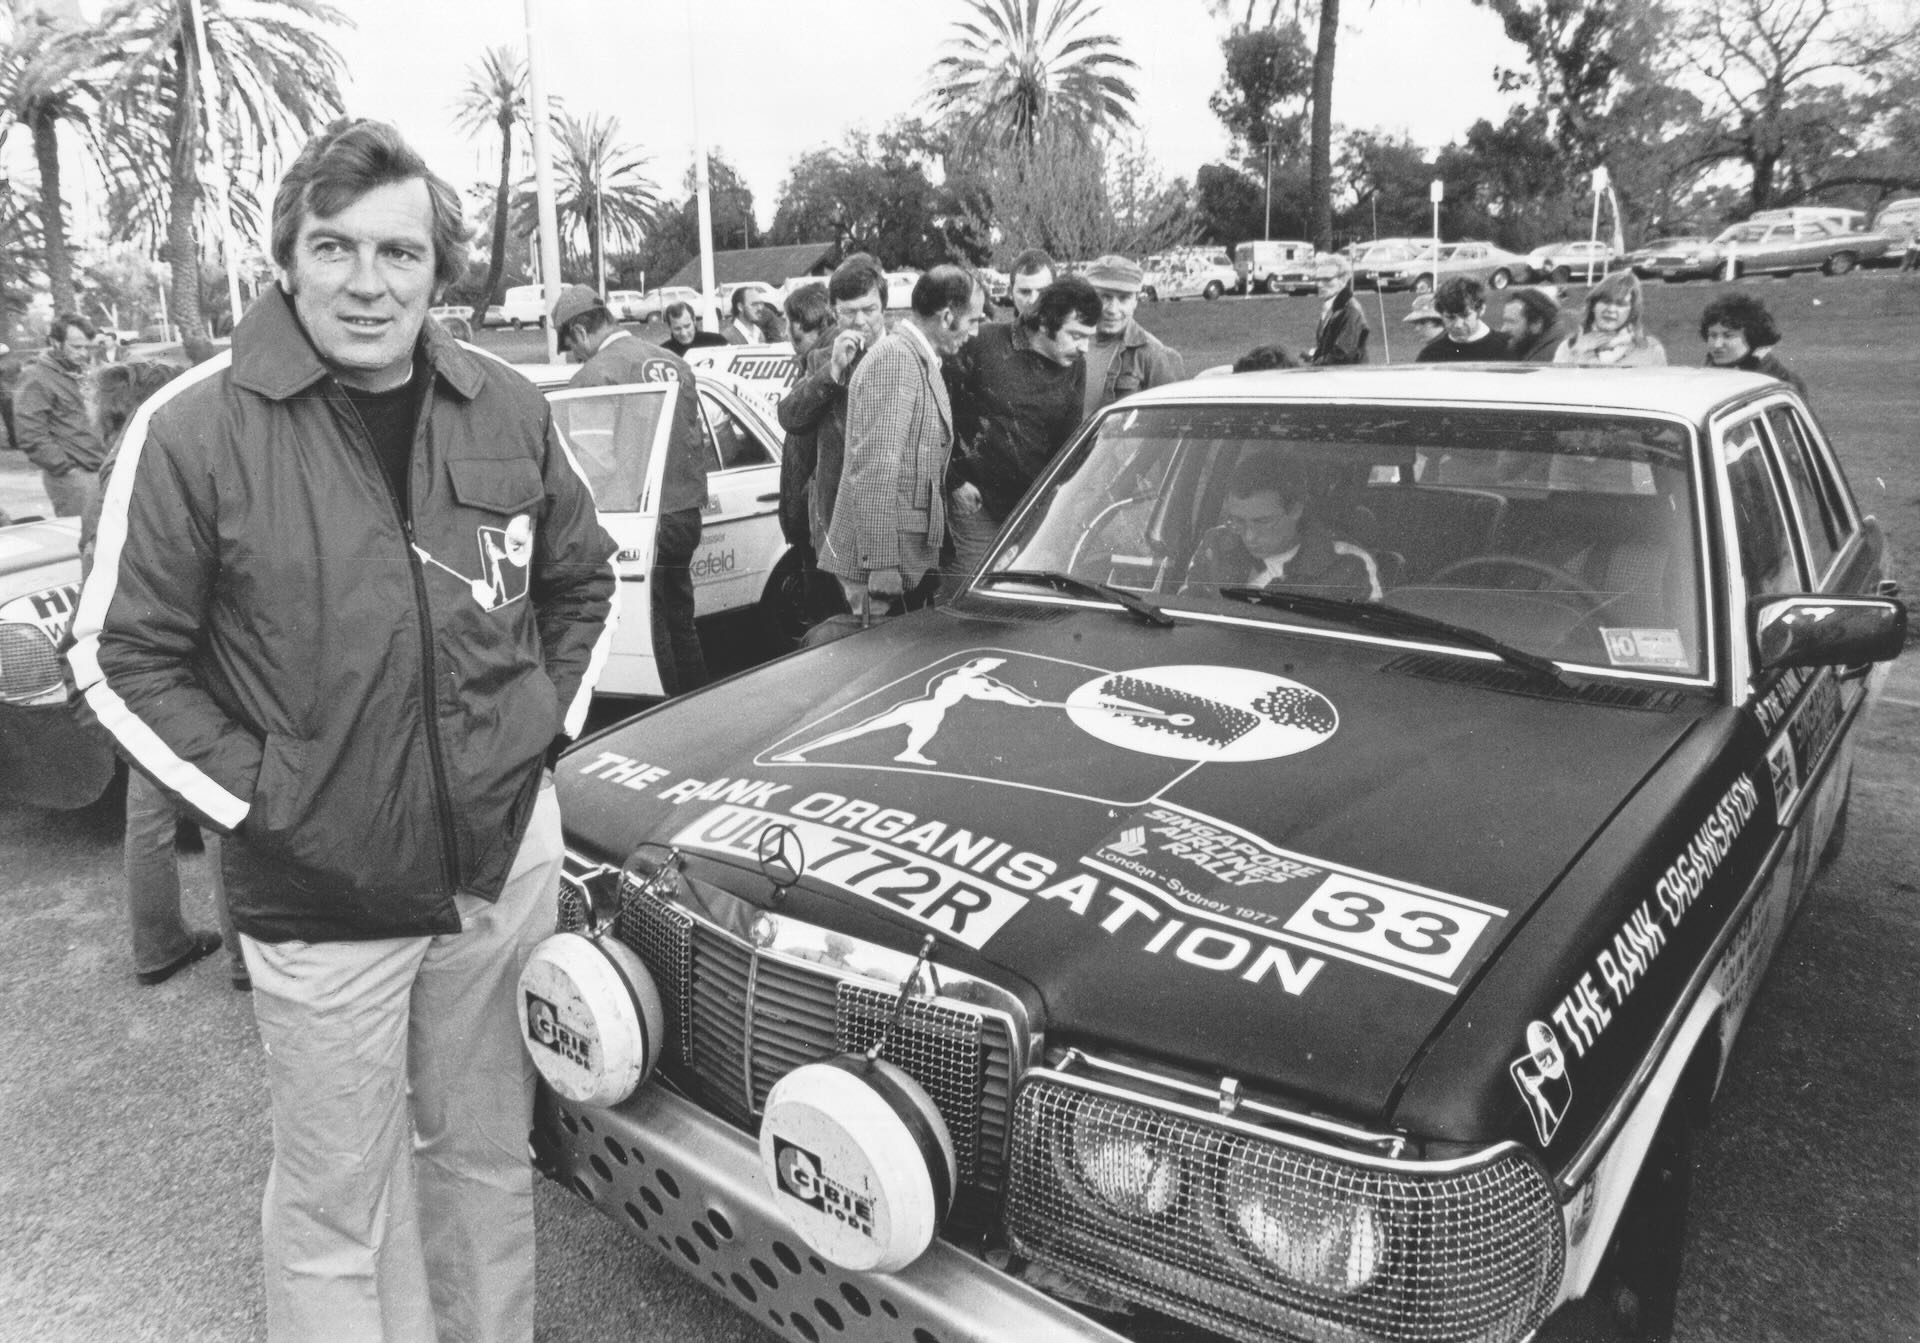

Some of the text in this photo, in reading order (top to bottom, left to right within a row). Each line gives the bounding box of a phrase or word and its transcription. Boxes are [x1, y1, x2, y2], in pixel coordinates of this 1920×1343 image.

[649, 362, 678, 383] STP
[579, 751, 1326, 996] THE RANK ORGANISATION
[701, 811, 993, 935] ULL 772R
[1144, 809, 1323, 877] SINGAPORE
[1150, 826, 1298, 884] AIRLINES
[1160, 842, 1266, 886] RALLY
[1235, 906, 1279, 924] 1977
[1312, 890, 1460, 956] 33
[1552, 772, 1758, 1058] THE RANK ORGANISATION
